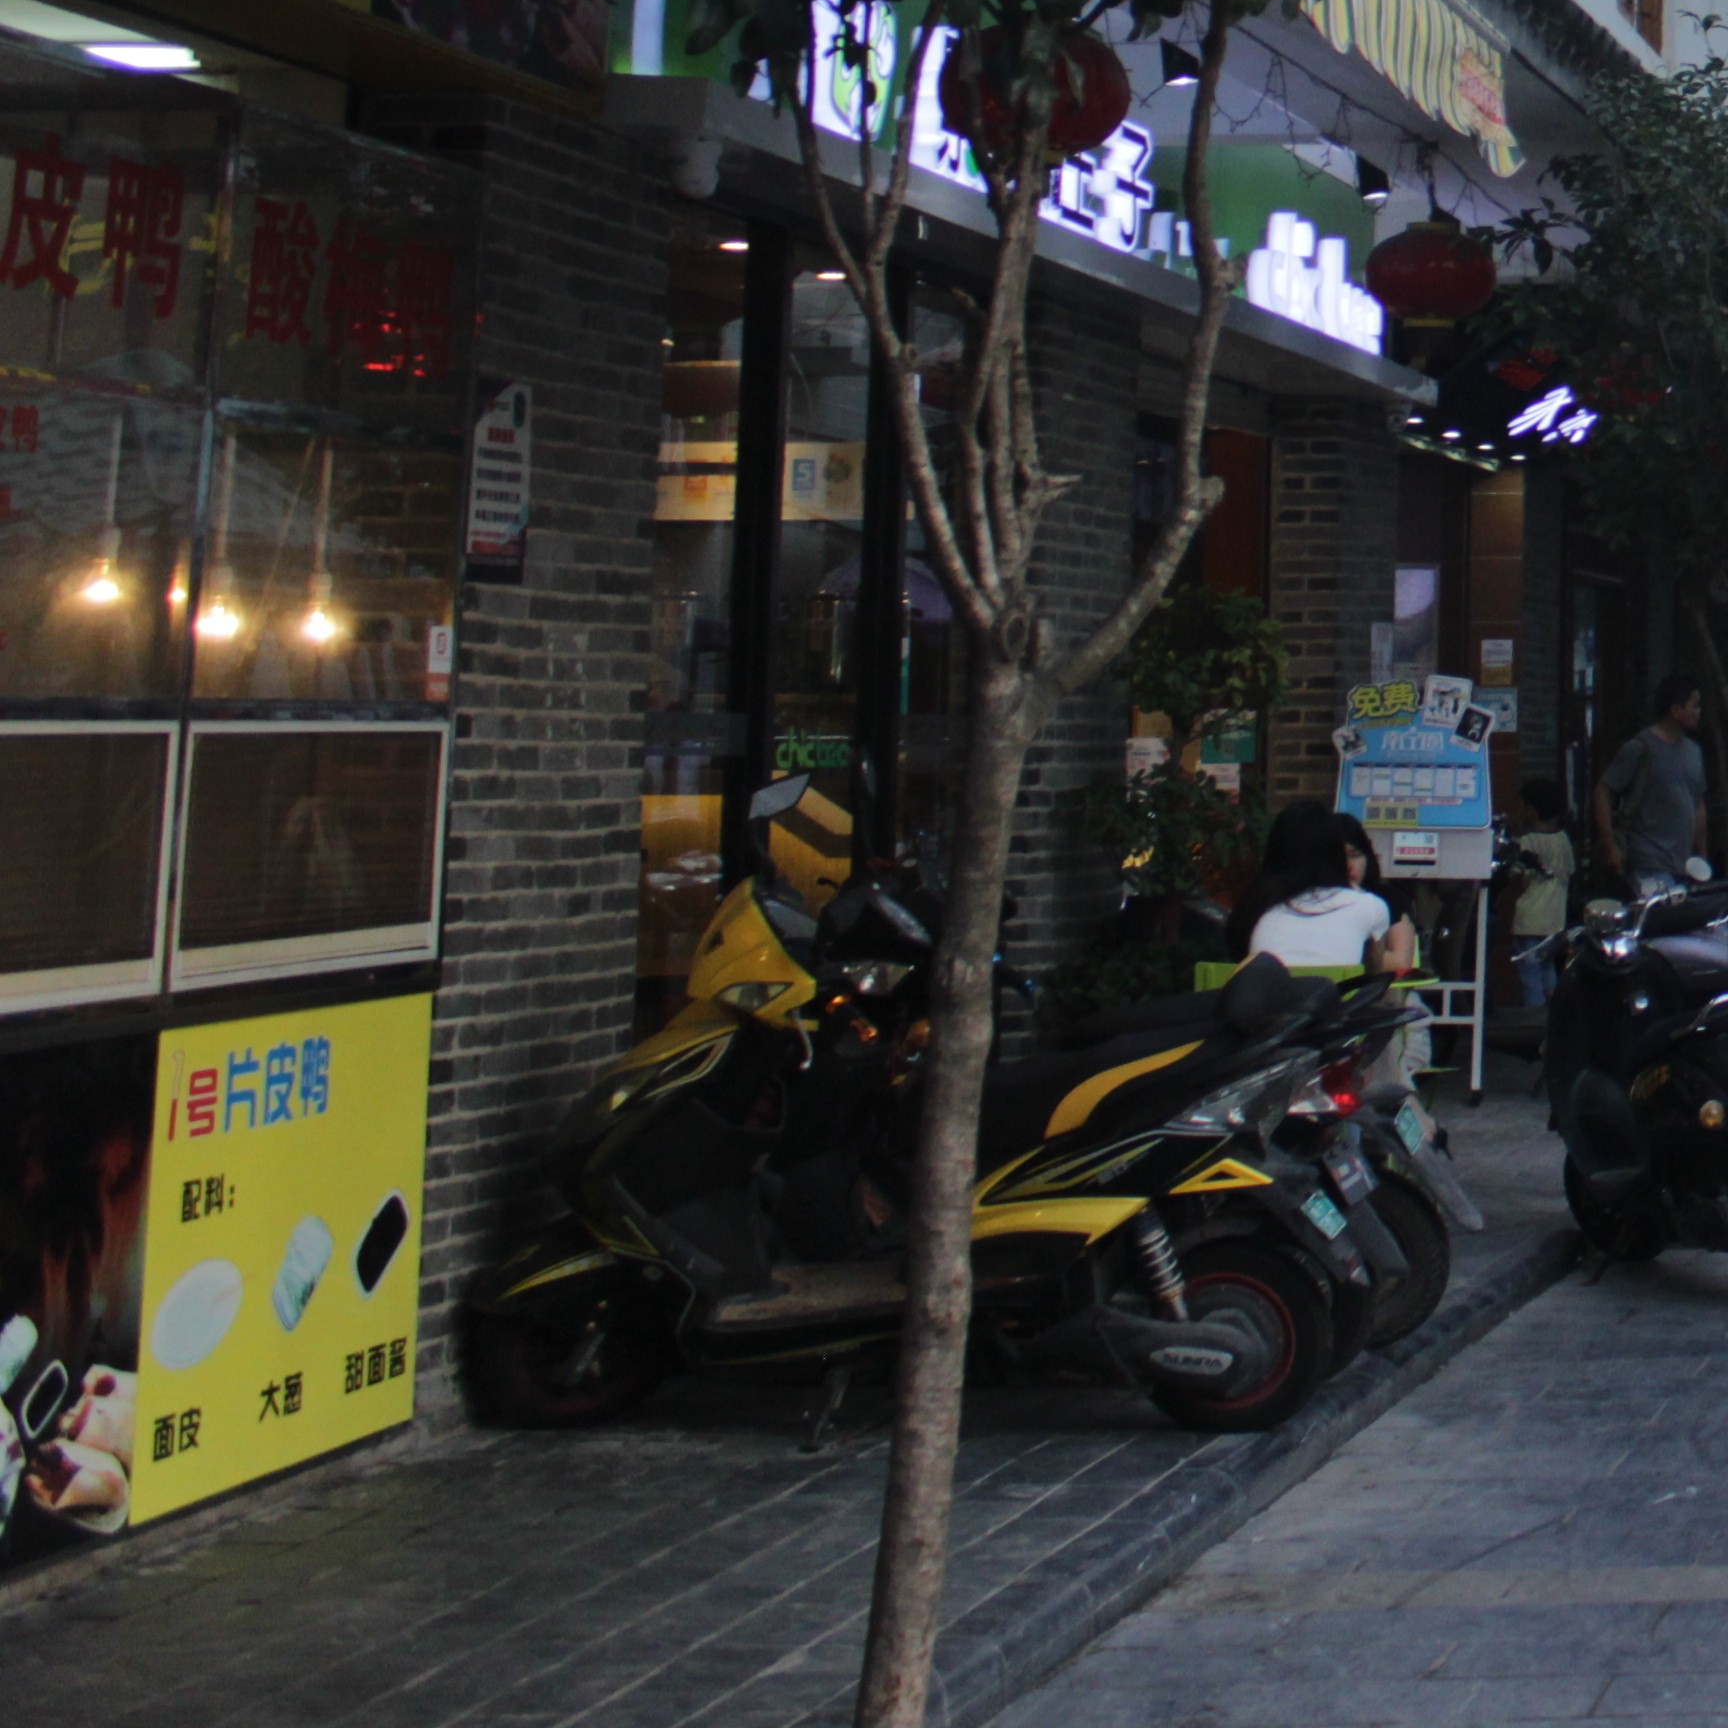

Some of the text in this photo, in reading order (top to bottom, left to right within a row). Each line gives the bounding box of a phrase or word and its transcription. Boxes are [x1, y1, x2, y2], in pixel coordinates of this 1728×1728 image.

[1352, 680, 1418, 719] 免费
[259, 1371, 304, 1422] 大葱
[153, 1407, 202, 1462] 面皮
